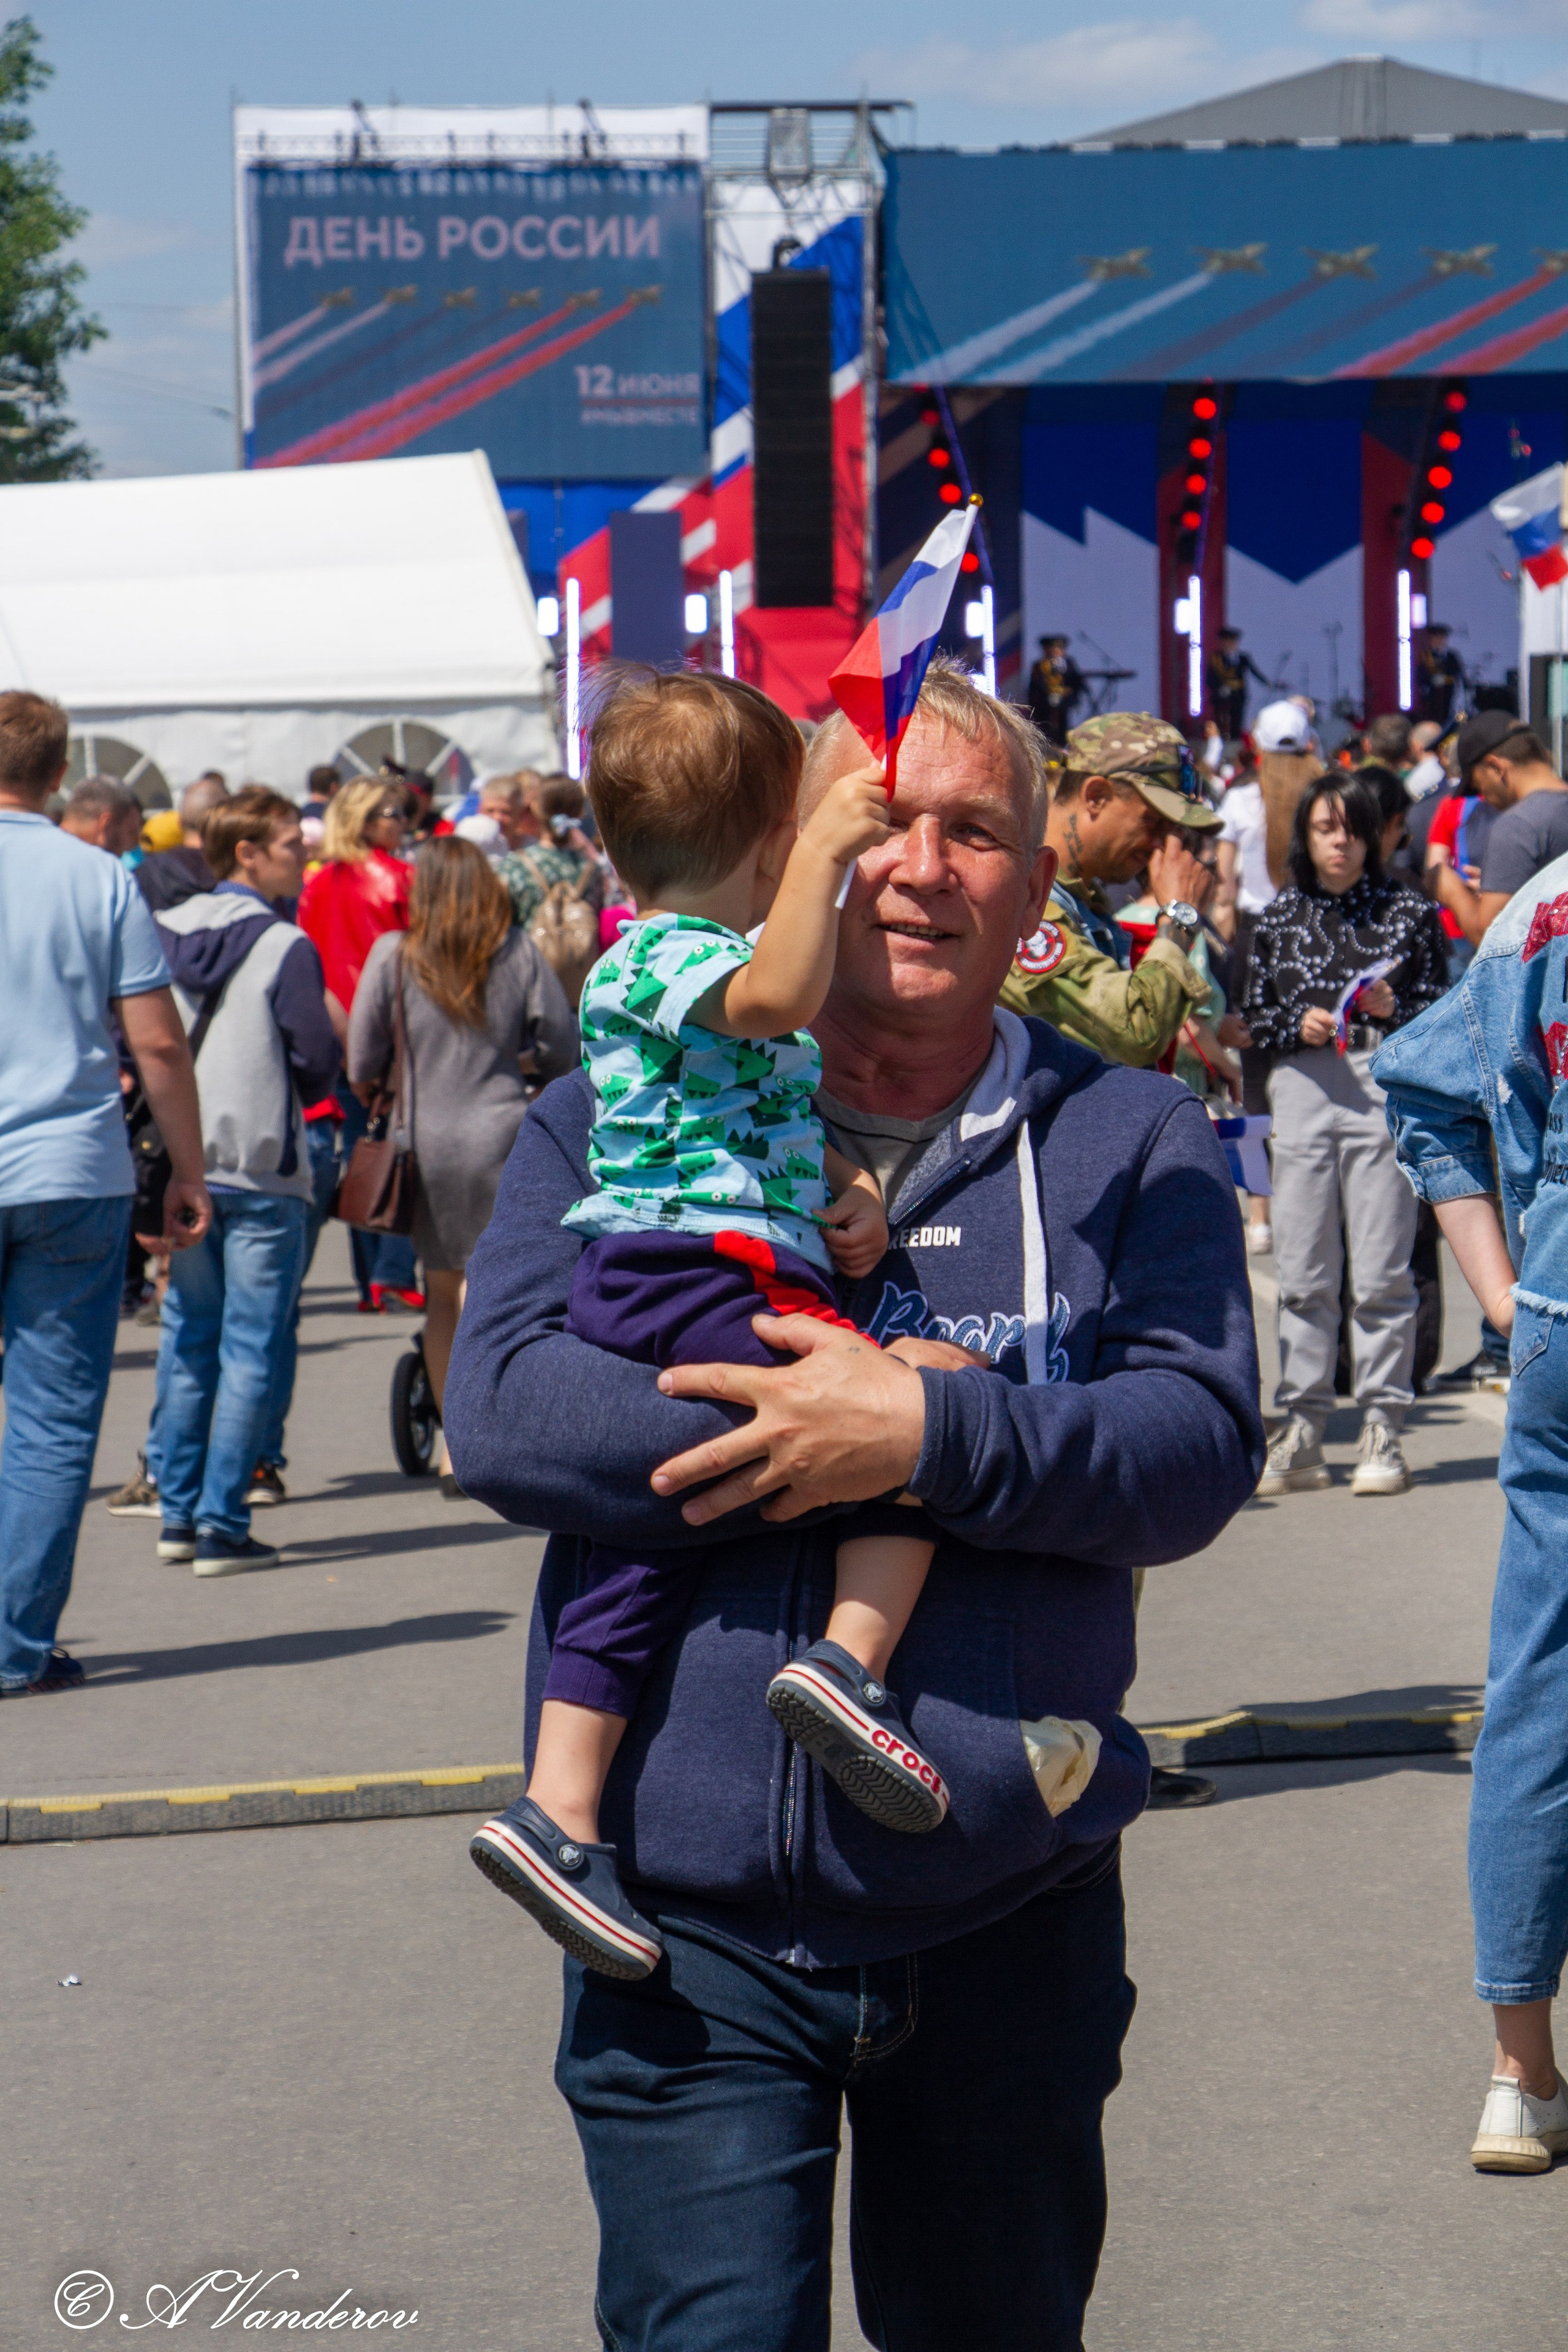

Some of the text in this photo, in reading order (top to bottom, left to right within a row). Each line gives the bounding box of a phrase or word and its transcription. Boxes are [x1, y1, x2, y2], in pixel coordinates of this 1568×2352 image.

[284, 214, 660, 269] ДЕНЬ РОССИИ
[573, 364, 700, 396] 12 ИЮНЯ
[888, 1226, 962, 1250] REEDOM
[872, 1730, 942, 1795] crocs
